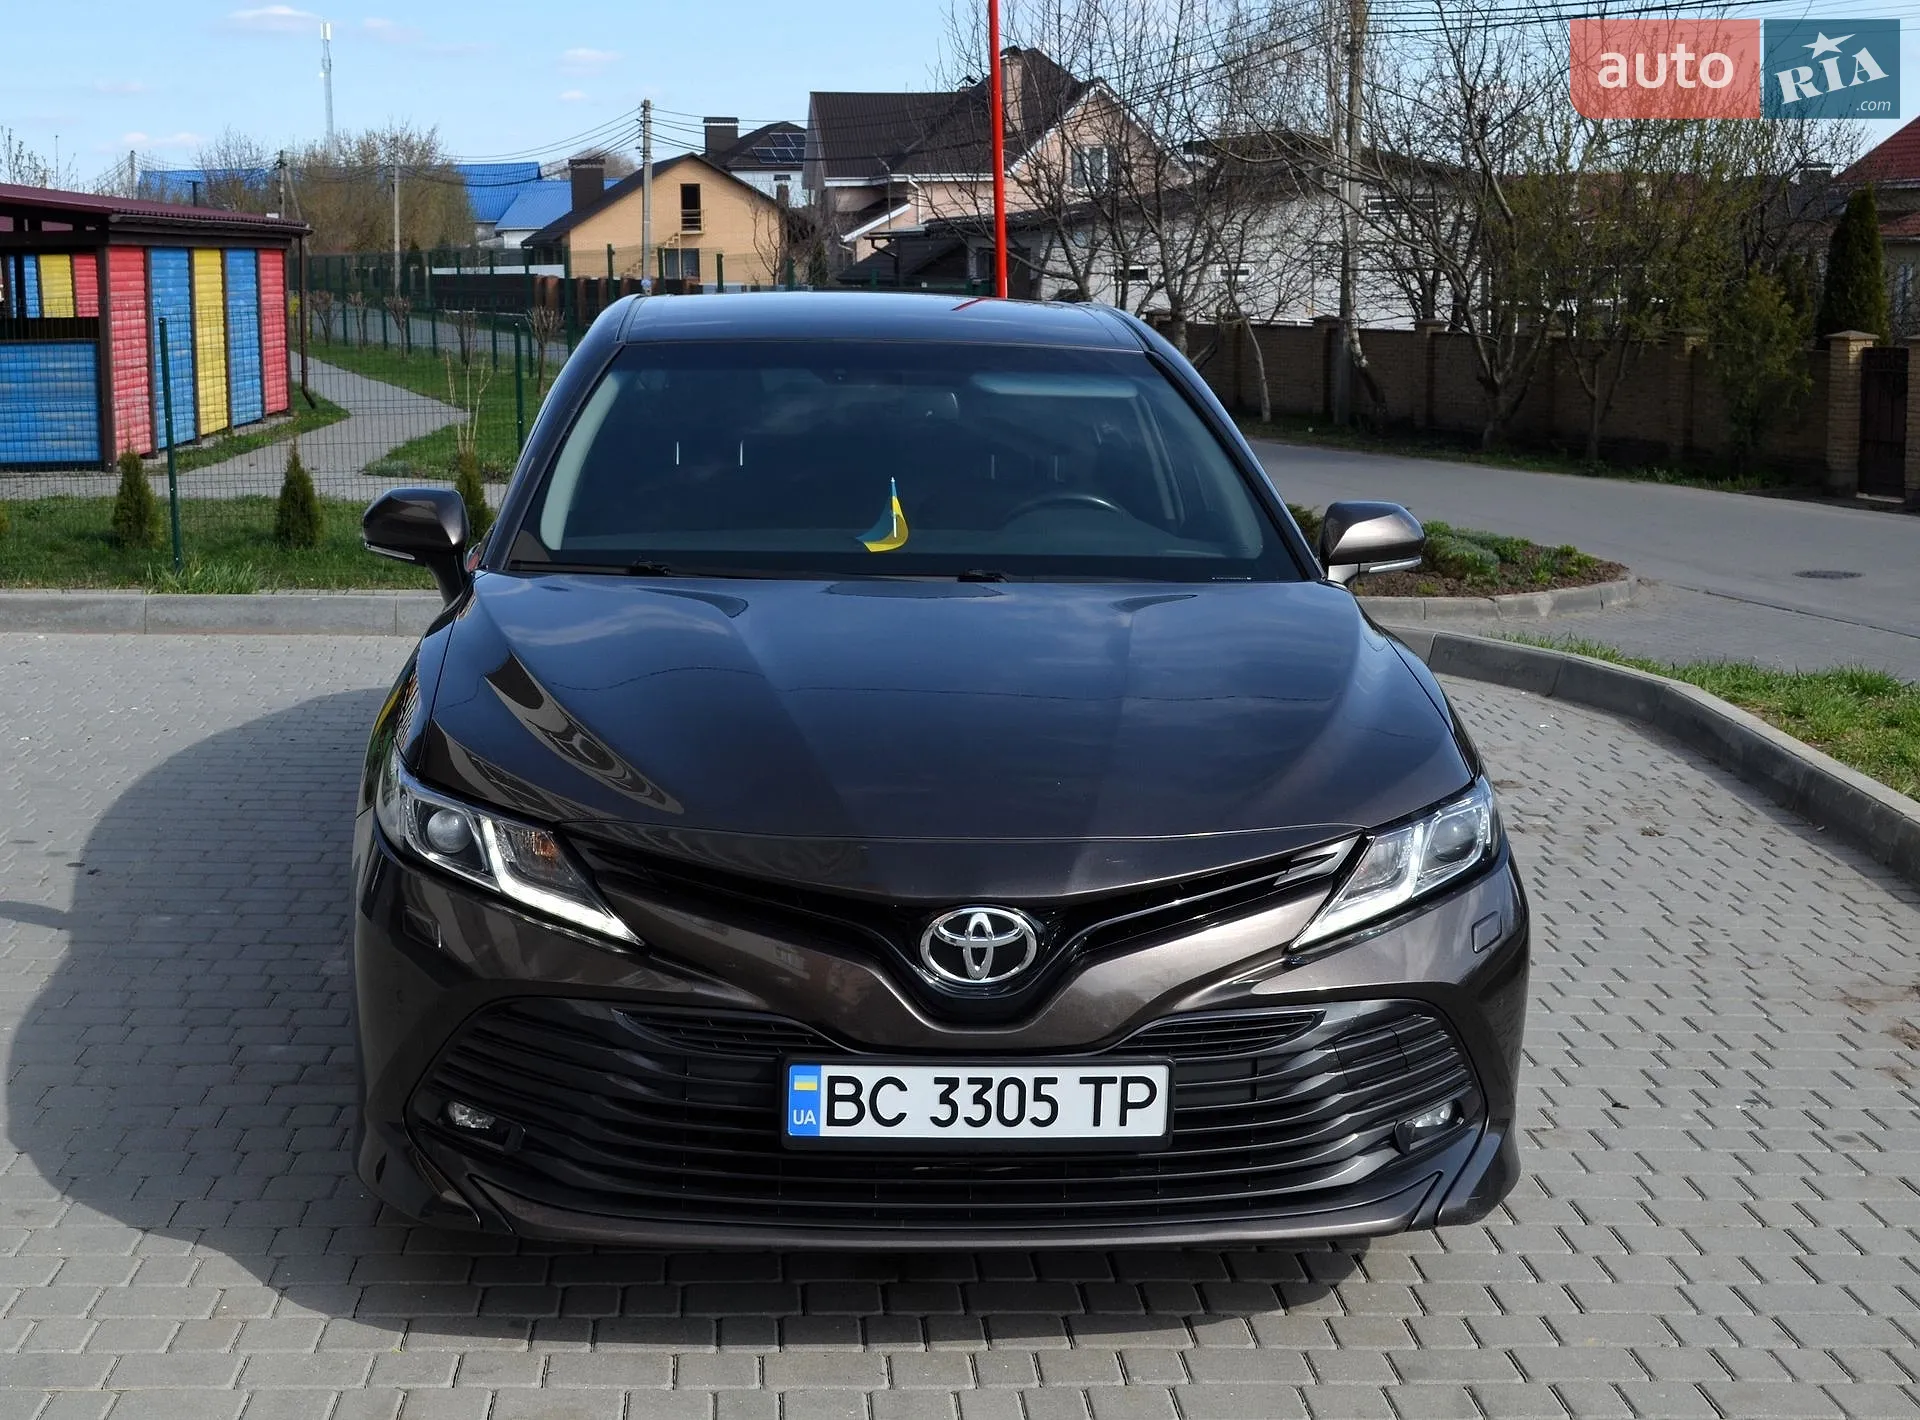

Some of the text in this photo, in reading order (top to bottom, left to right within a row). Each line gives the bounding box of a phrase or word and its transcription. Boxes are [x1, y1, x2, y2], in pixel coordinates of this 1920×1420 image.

[793, 1108, 816, 1126] UA
[826, 1075, 1158, 1128] BC 3305 TP
